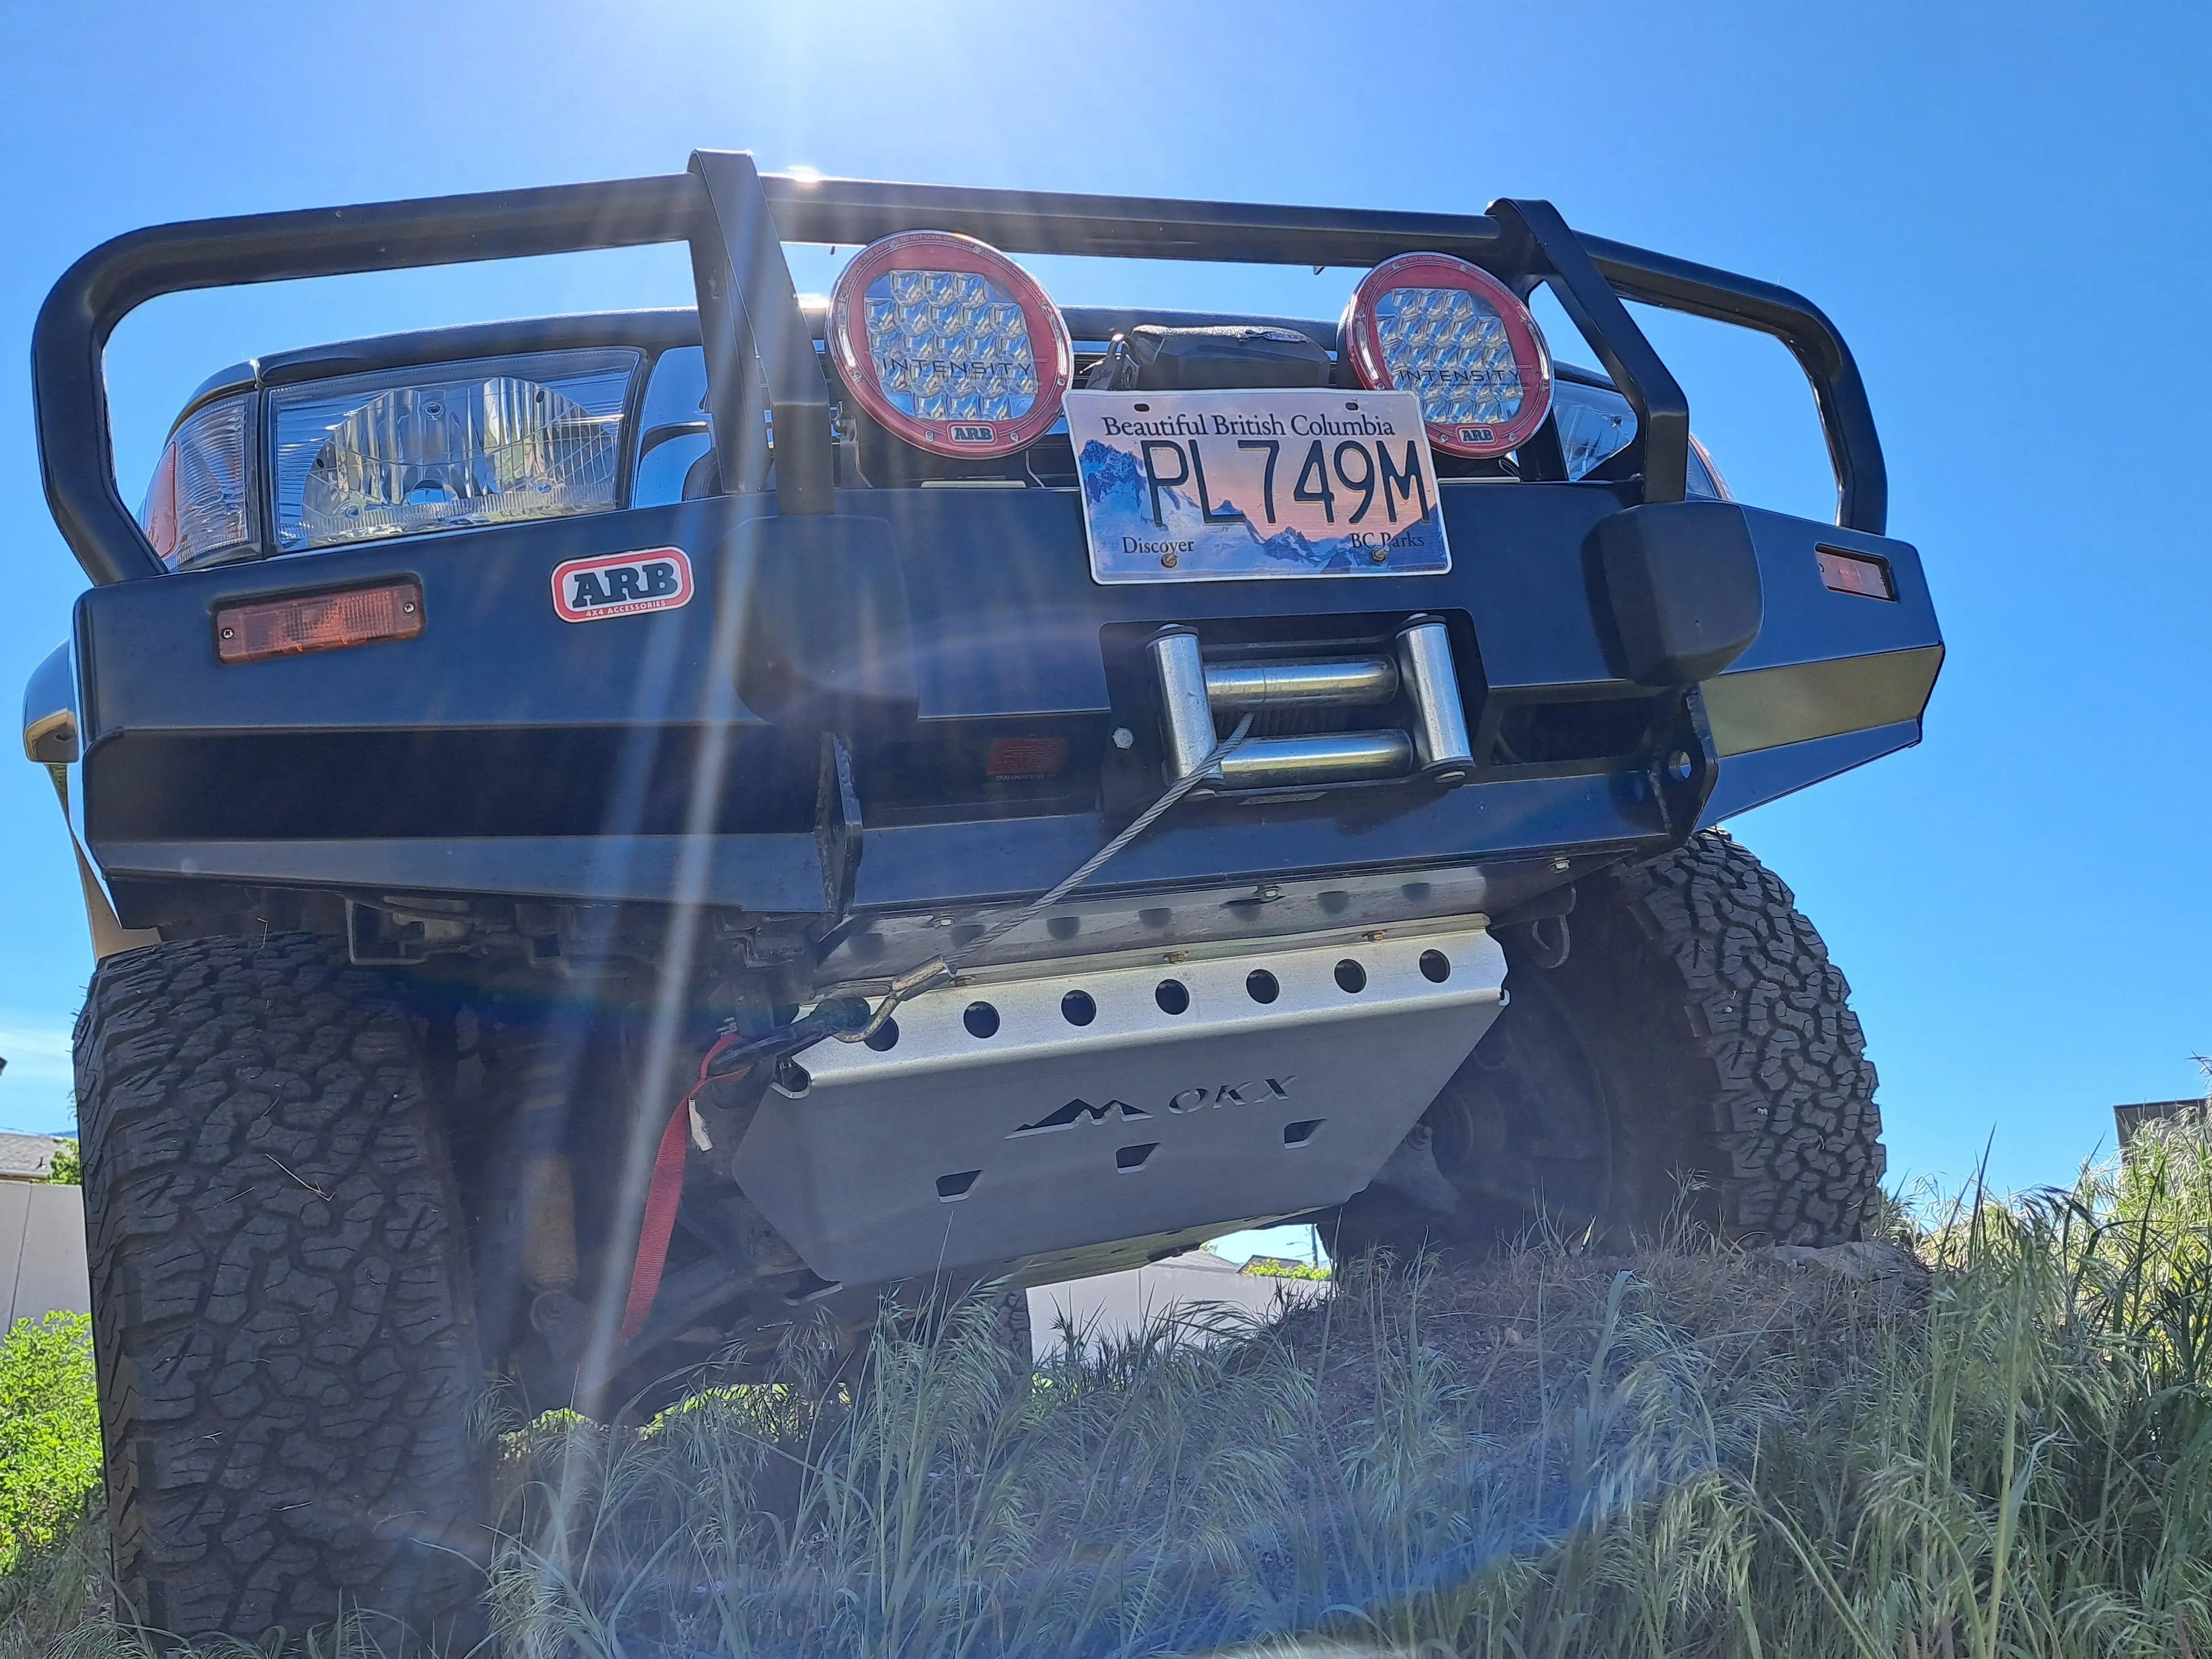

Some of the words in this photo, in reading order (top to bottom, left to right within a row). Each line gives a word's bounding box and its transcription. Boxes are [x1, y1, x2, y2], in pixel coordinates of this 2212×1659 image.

[882, 358, 1034, 375] INTENSITY
[1399, 370, 1522, 383] INTENSITY
[1101, 413, 1209, 436] Beautiful
[1211, 413, 1287, 436] British
[1290, 413, 1396, 436] Columbia
[954, 428, 992, 441] ARB
[1462, 428, 1493, 442] ARB
[1121, 537, 1195, 557] Discover
[1349, 533, 1375, 549] BC
[1380, 531, 1425, 548] Parks
[572, 562, 678, 608] ARB
[586, 608, 604, 617] 4X4
[607, 600, 666, 615] ACCESSORIES
[1167, 1075, 1298, 1114] OKX
